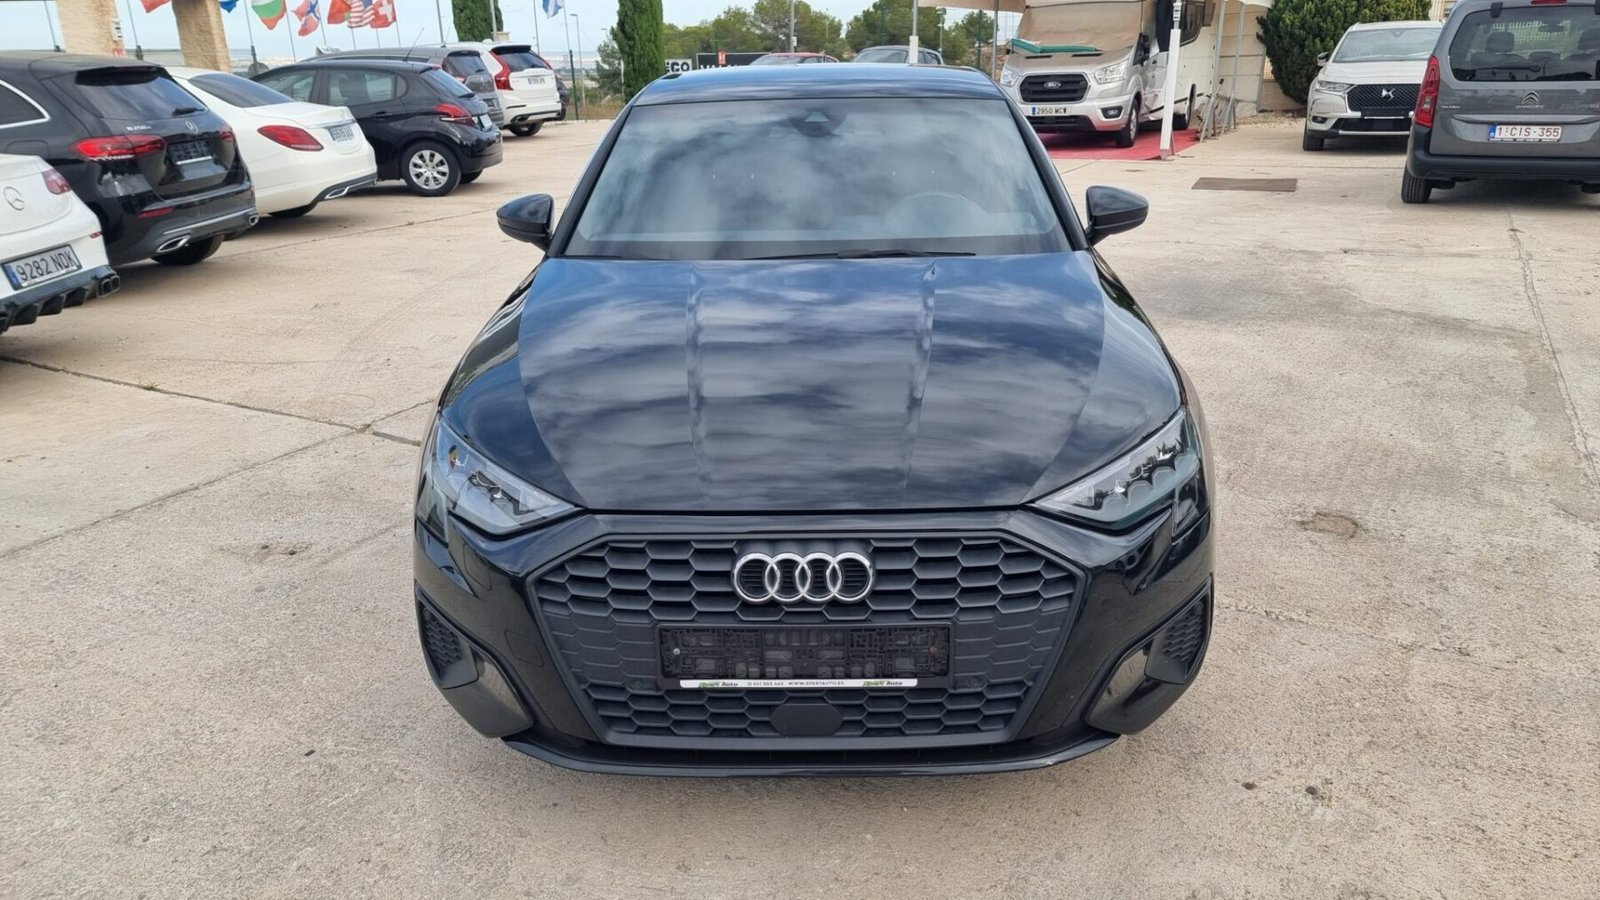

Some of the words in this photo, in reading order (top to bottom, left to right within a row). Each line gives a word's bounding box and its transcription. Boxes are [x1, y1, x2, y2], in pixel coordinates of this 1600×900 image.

[1037, 107, 1053, 115] 2950
[16, 258, 52, 281] 9282
[50, 251, 77, 271] NDK
